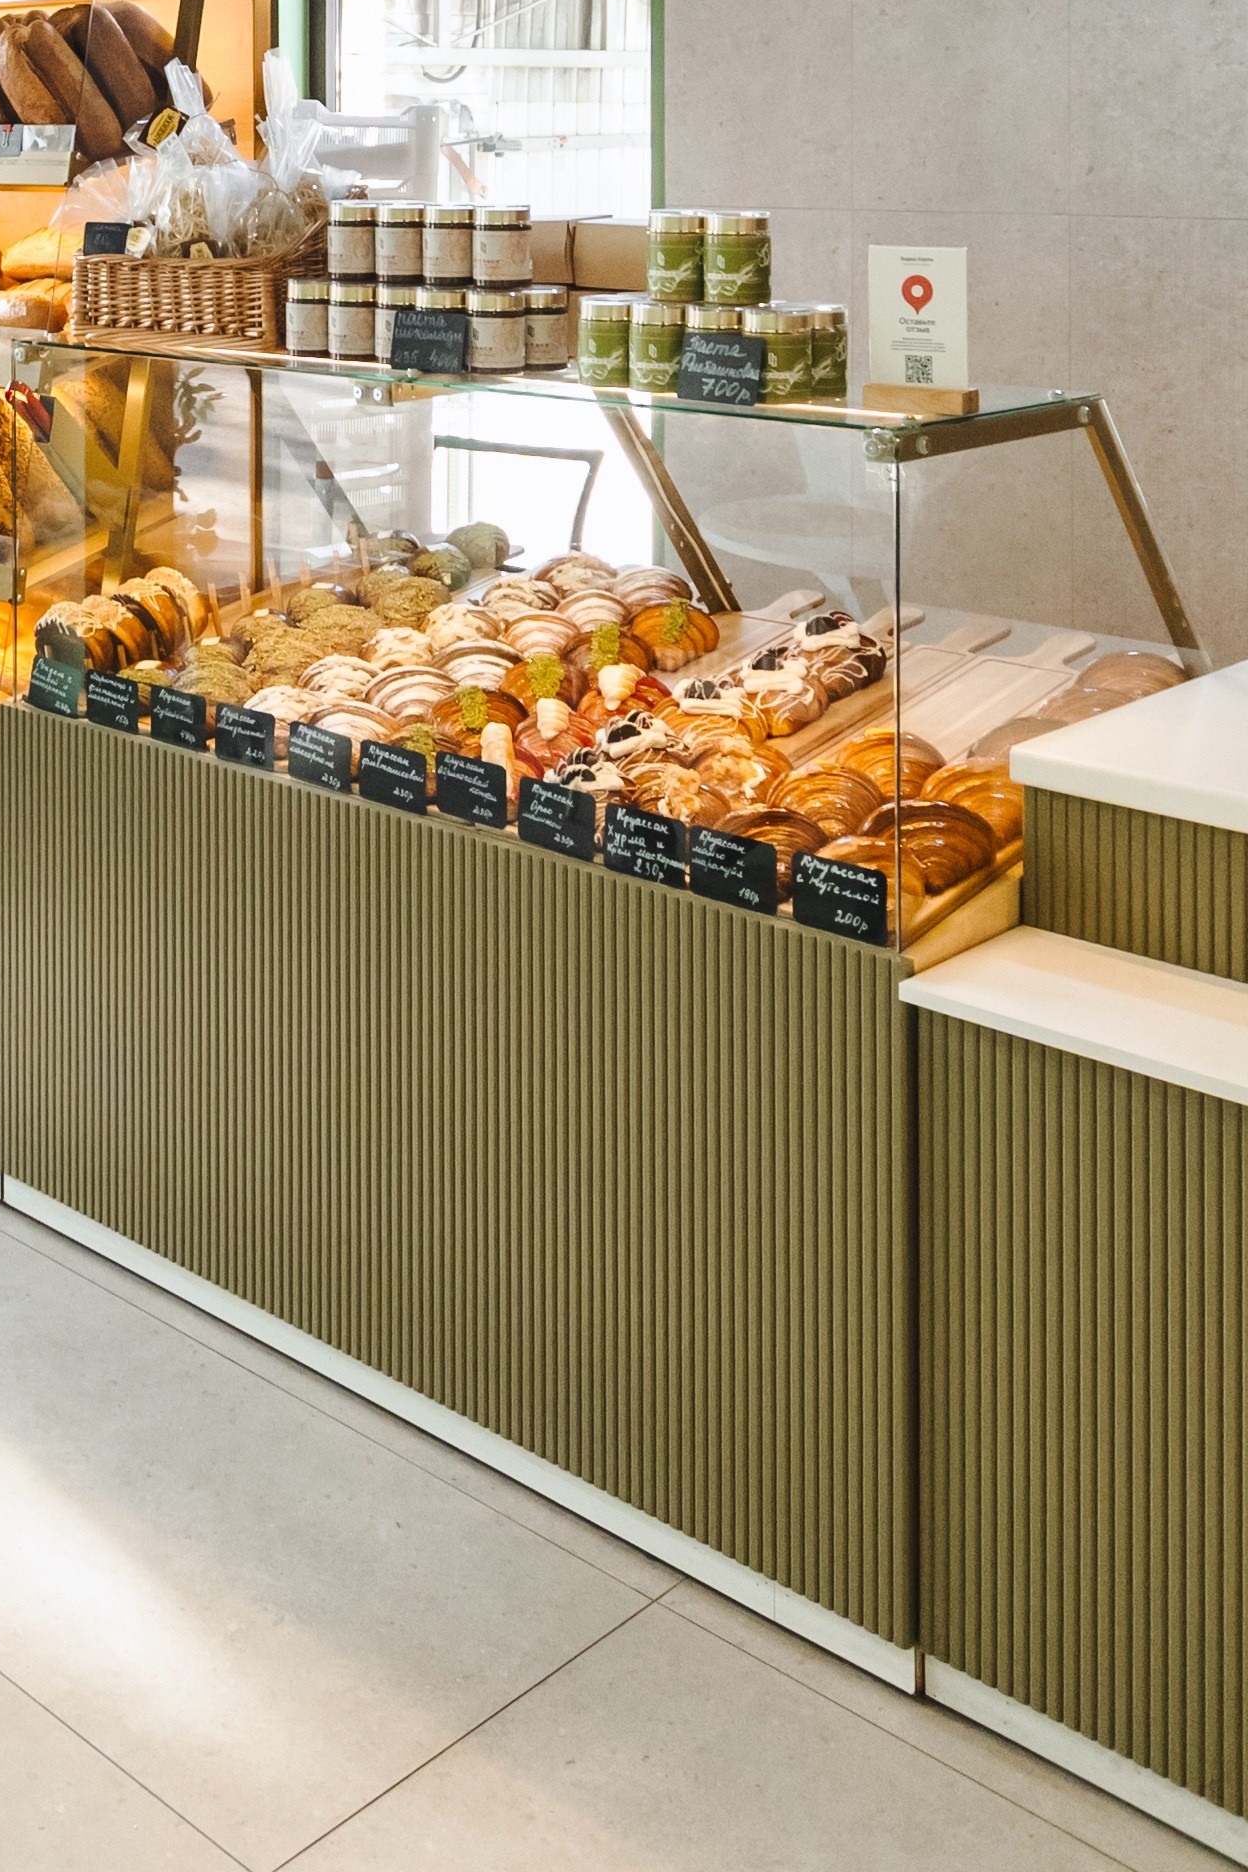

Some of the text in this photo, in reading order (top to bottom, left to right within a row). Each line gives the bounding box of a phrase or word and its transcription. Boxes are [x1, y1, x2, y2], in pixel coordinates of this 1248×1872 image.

[899, 316, 936, 326] Оставьте
[616, 807, 670, 835] Круассан
[698, 829, 747, 855] Круассан
[800, 854, 878, 888] Круассан
[834, 909, 869, 935] 200р
